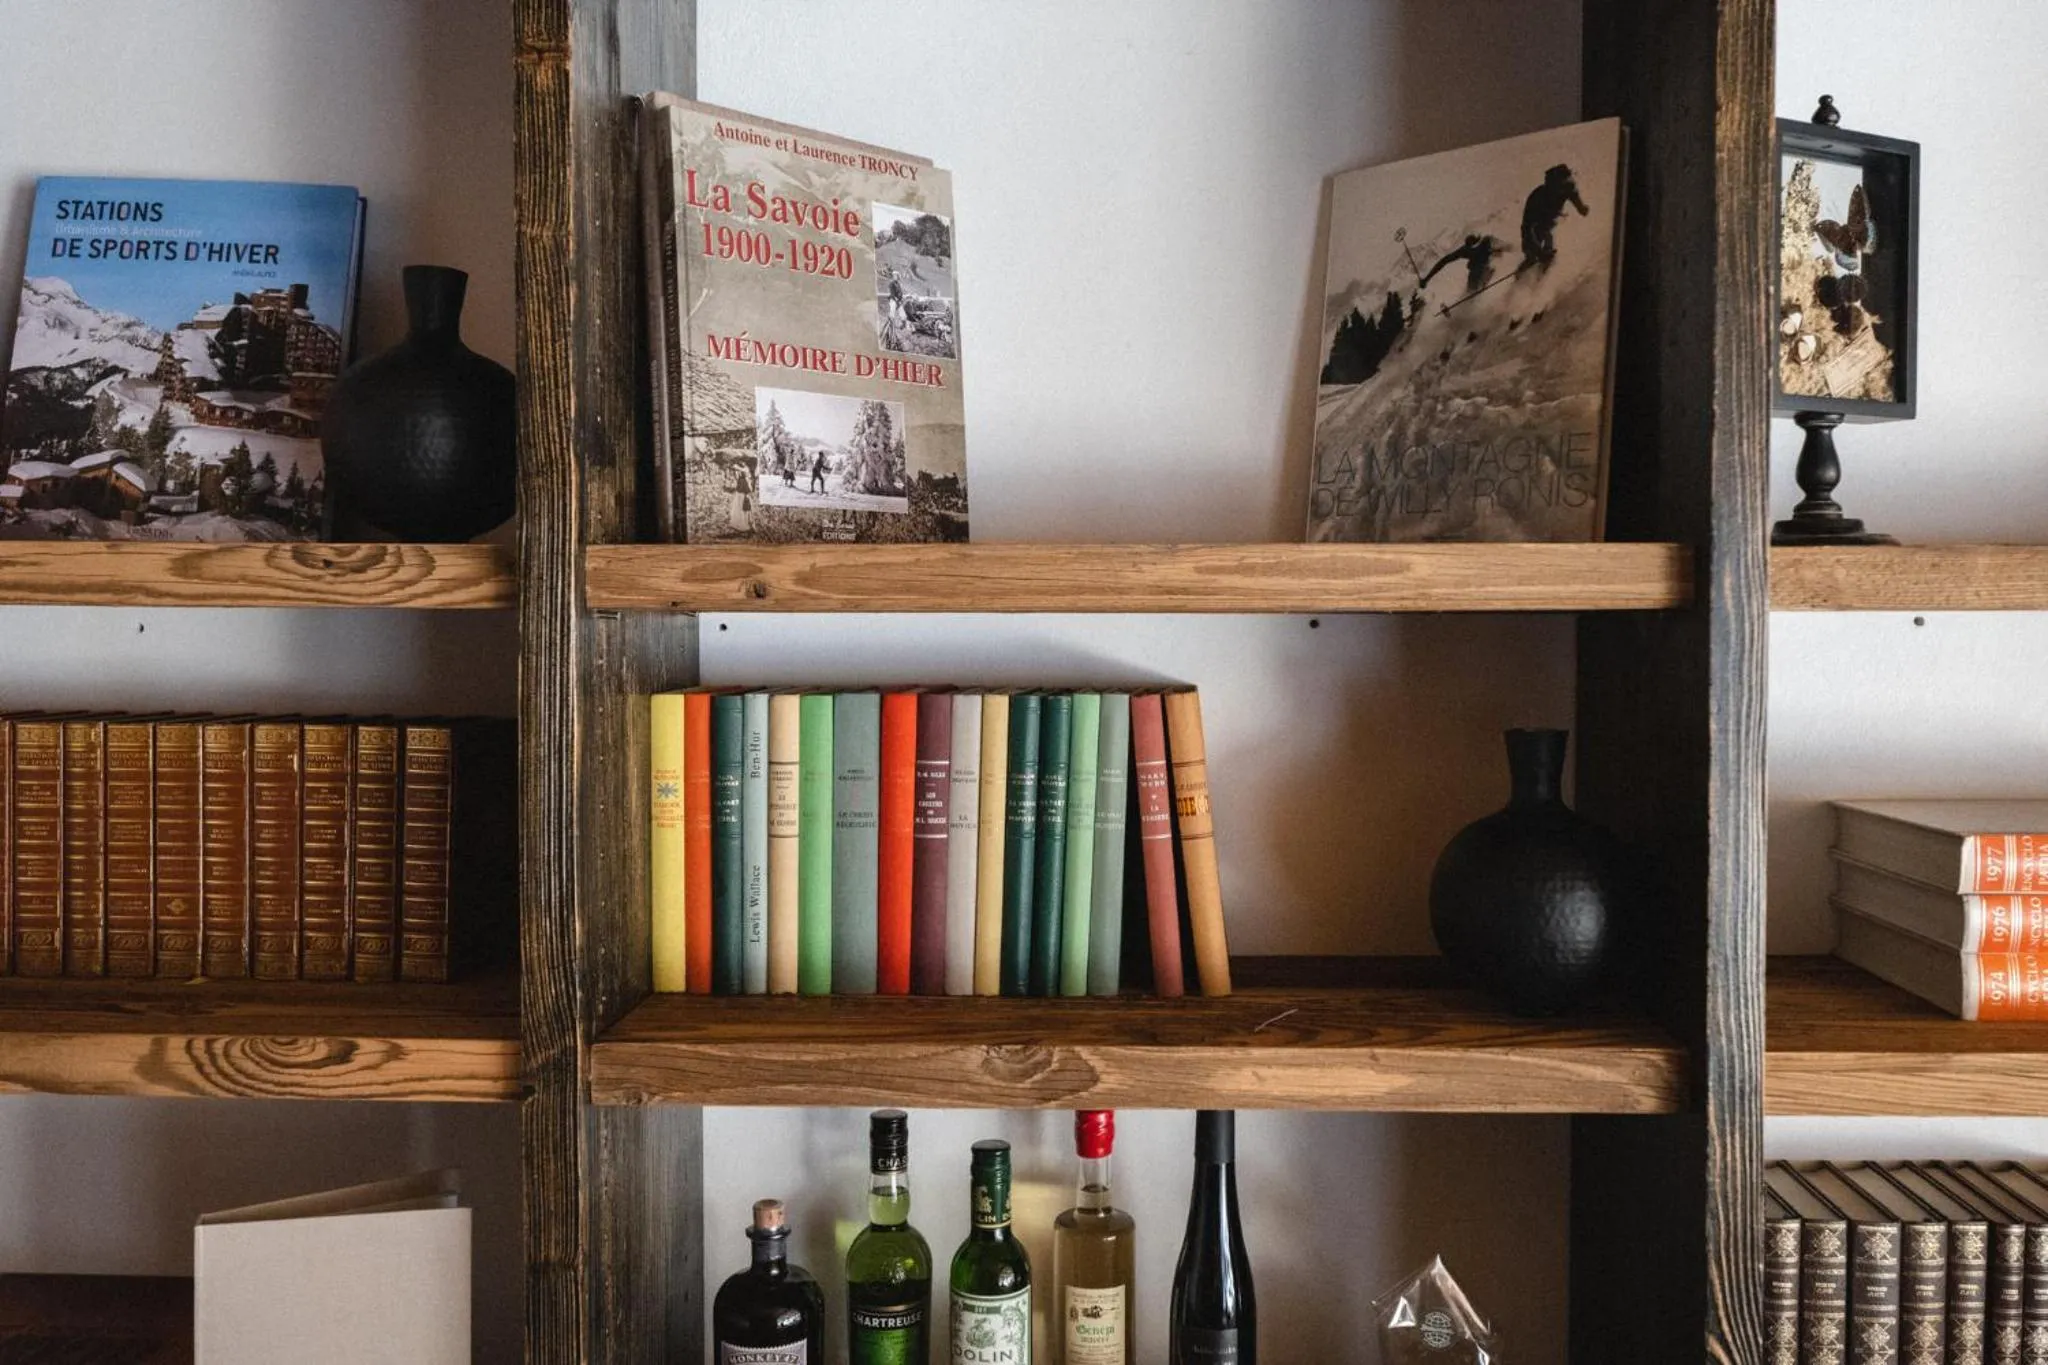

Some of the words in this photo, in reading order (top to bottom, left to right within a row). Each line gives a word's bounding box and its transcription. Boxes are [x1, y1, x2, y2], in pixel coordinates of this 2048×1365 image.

[713, 121, 771, 149] Antoine
[775, 136, 789, 153] et
[793, 141, 857, 168] Laurence
[858, 153, 919, 182] TRONCY
[56, 200, 164, 222] STATIONS
[684, 168, 732, 214] La
[745, 180, 861, 237] Savoie
[51, 237, 83, 259] DE
[88, 238, 178, 262] SPORTS
[184, 240, 280, 266] D'HIVER
[702, 223, 855, 281] 1900-1920
[706, 331, 848, 377] MÉMOIRE
[855, 353, 947, 388] D'HIER
[1316, 450, 1356, 485] LA
[1367, 432, 1593, 483] MONTAGNE
[1312, 487, 1356, 518] DE
[1473, 472, 1590, 510] RONIS
[750, 731, 762, 779] Ben-Hur
[750, 864, 761, 908] Wallace
[1987, 847, 2003, 882] 1977
[750, 909, 761, 943] Lewis
[1992, 906, 2010, 942] 1976
[1991, 971, 2008, 1005] 1974
